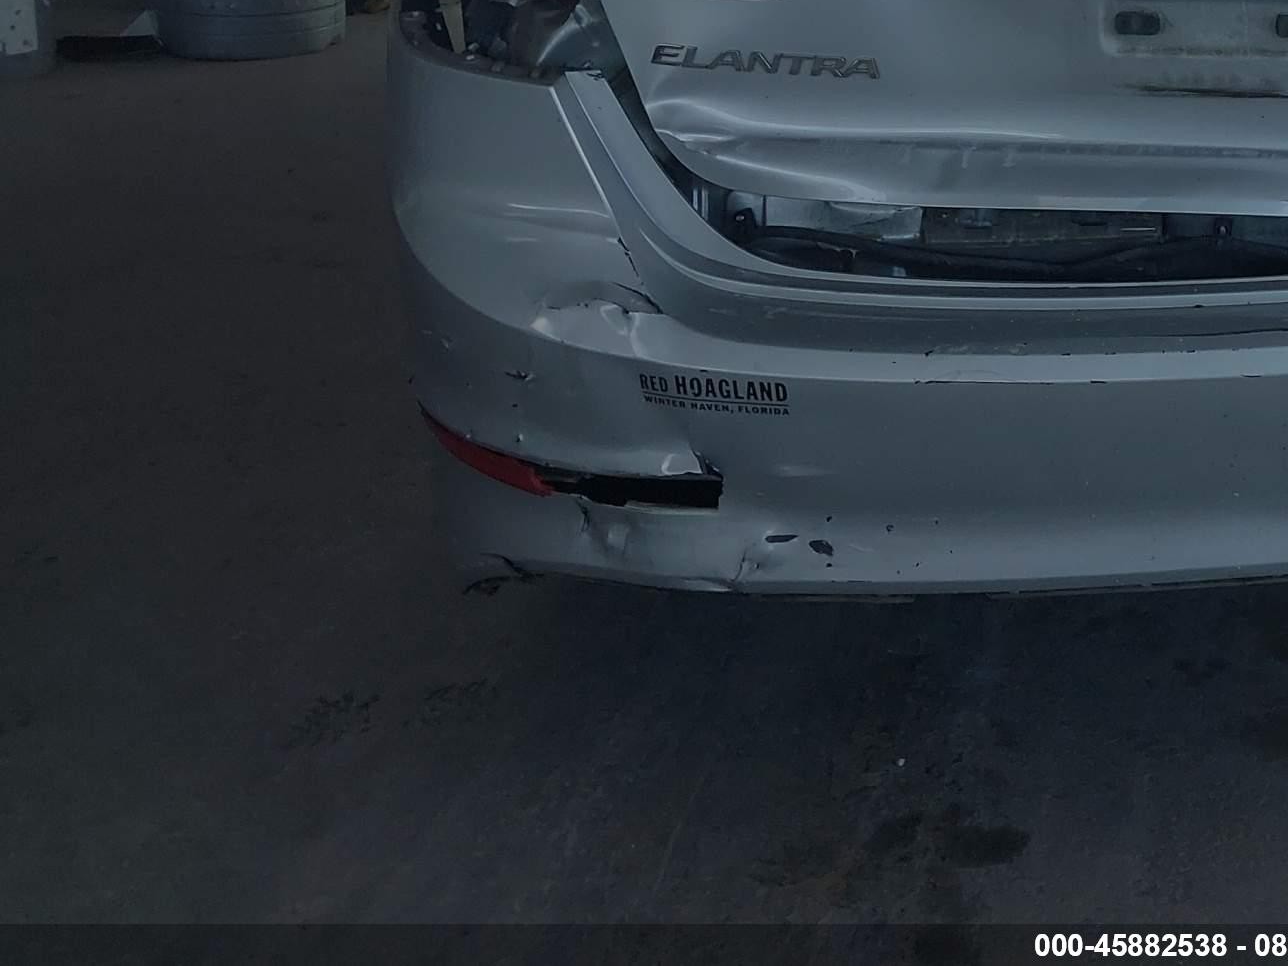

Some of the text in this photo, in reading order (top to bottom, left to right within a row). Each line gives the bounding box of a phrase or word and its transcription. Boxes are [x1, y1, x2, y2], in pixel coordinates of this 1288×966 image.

[651, 43, 880, 79] ELANTRA
[639, 374, 788, 402] RED HOAGLAND
[643, 396, 790, 416] WINTER HAVEN, FLORIDA
